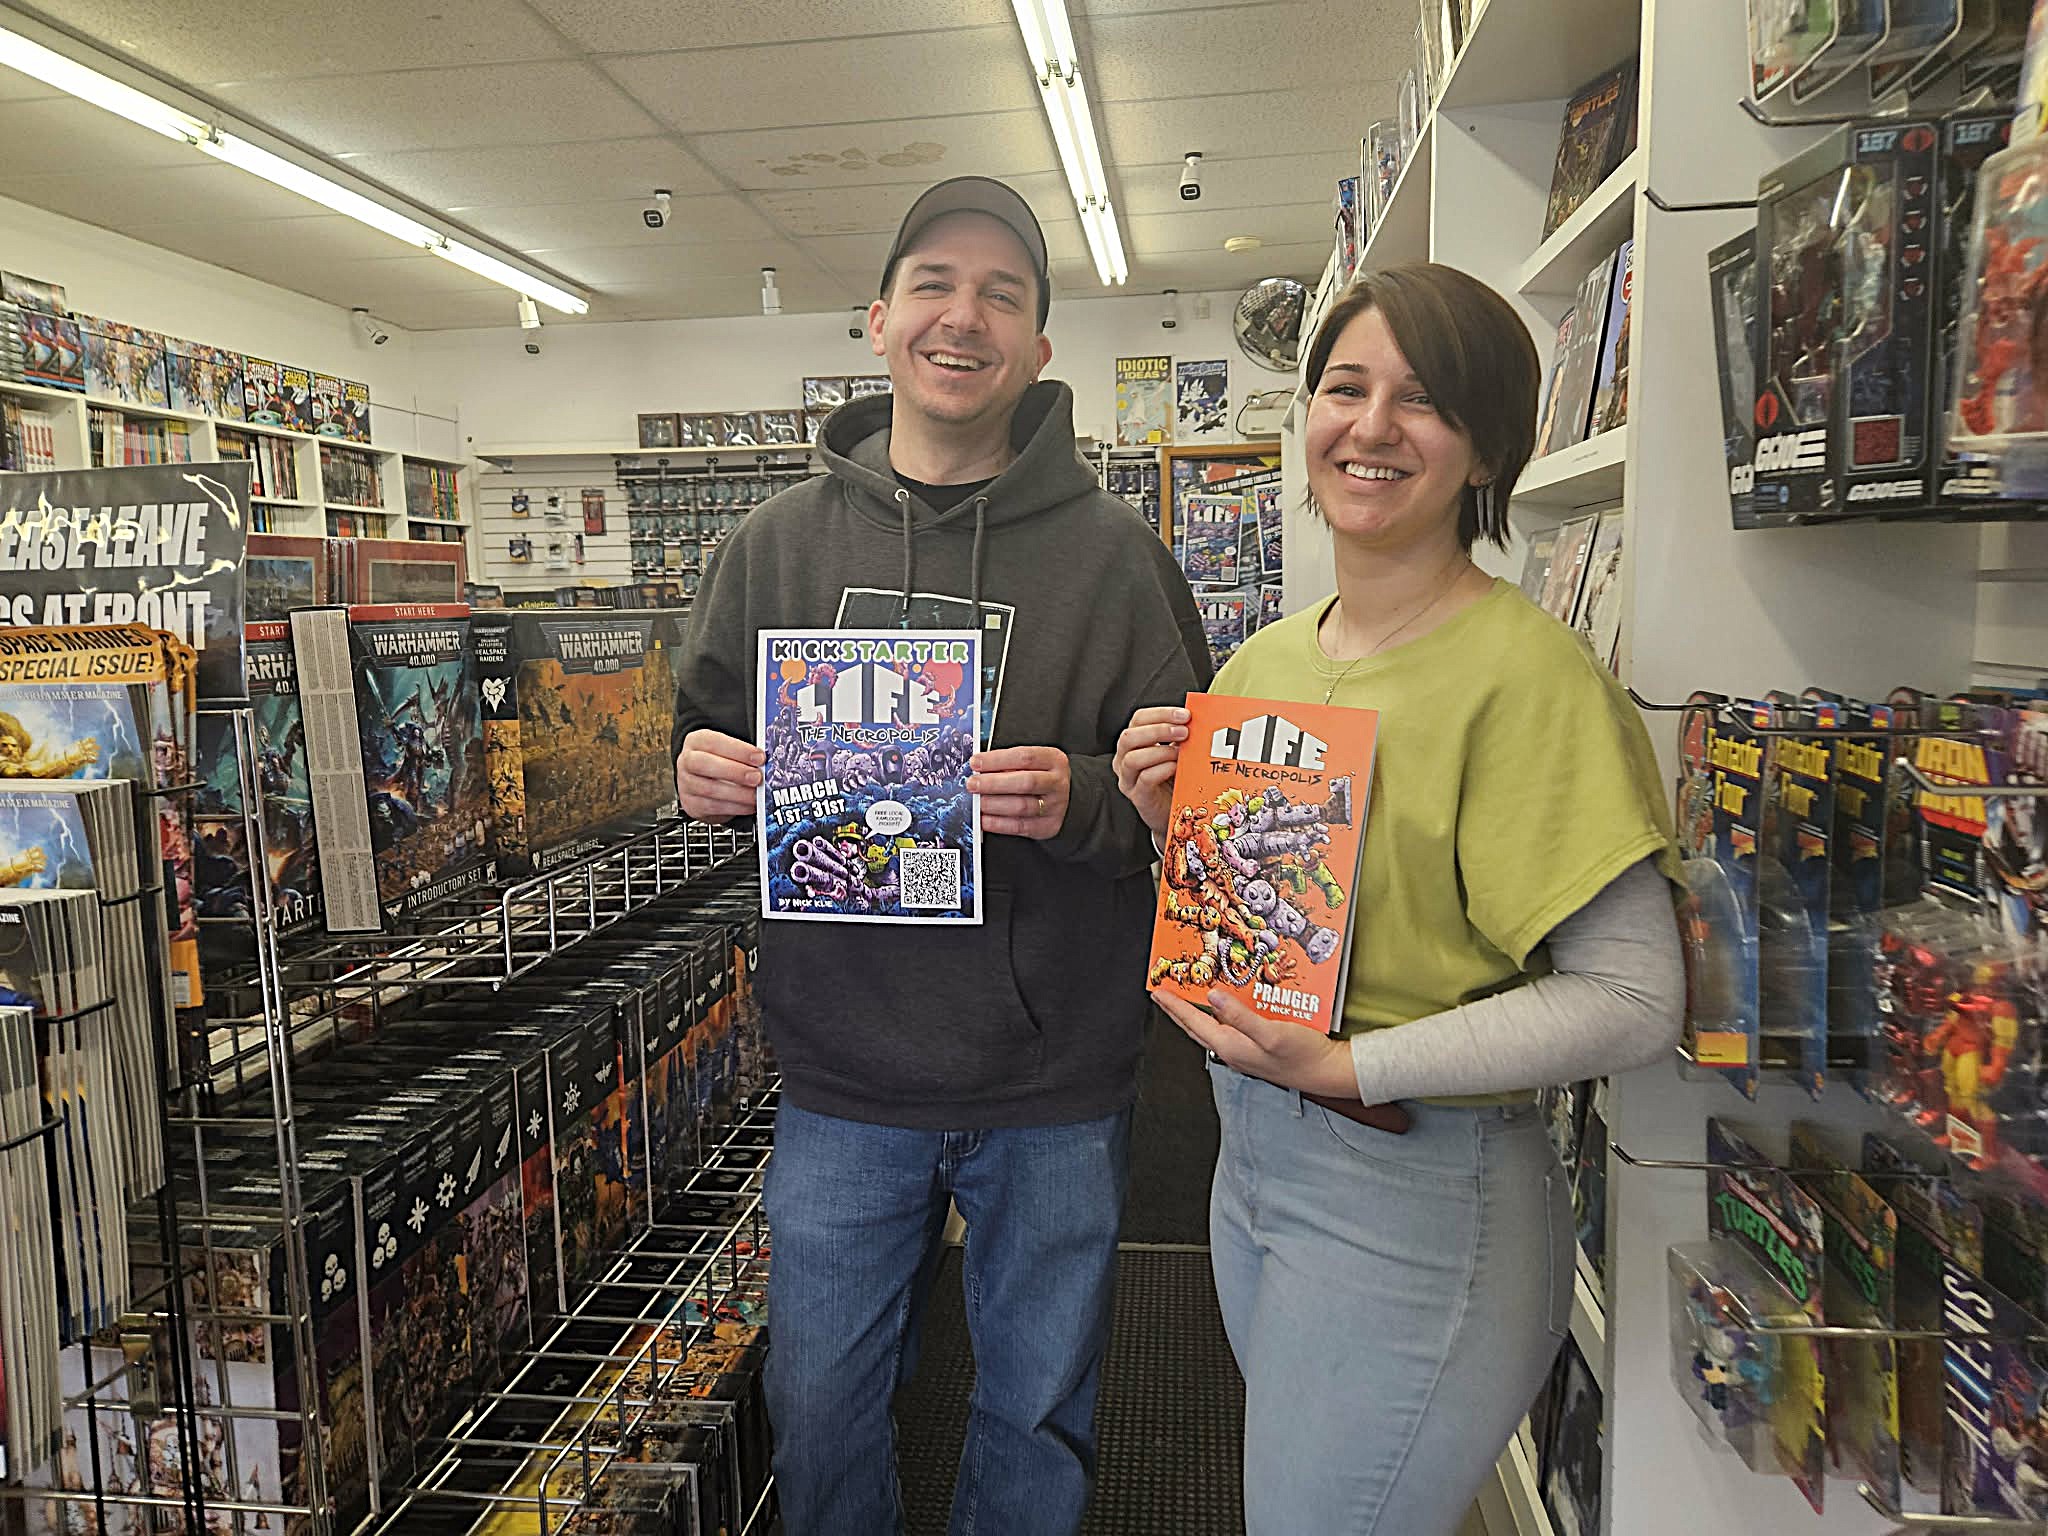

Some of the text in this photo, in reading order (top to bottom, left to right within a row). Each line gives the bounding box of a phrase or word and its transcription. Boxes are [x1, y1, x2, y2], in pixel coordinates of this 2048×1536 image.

[1117, 358, 1168, 372] IDIOTIC
[1124, 371, 1160, 380] IDEAS
[95, 502, 209, 569] LEAVE
[42, 593, 87, 626] AT
[94, 590, 211, 650] FRONT
[395, 606, 436, 617] START HERE
[0, 627, 153, 656] SPACE MARINES
[259, 625, 285, 637] START
[373, 631, 461, 657] WARHAMMER
[558, 630, 644, 660] WARHAMMER
[771, 639, 969, 664] KICKSTARTER
[0, 652, 155, 681] SPECIAL ISSUE!
[796, 663, 940, 725] LIFE
[796, 724, 940, 746] THE NECROPOLIS
[1210, 714, 1329, 770] LIFE
[1210, 760, 1323, 786] THE NECROPOLIS
[772, 778, 839, 807] MARCH
[774, 807, 801, 826] 1ST
[811, 798, 845, 818] 31ST
[542, 846, 575, 868] REALSPACE
[576, 837, 599, 853] RAIDERS
[407, 867, 482, 909] INTRODUCTORY SET
[792, 898, 813, 907] NICK
[1252, 981, 1321, 1014] PRANGER
[1270, 1004, 1292, 1016] NICK
[1715, 1191, 1808, 1300] TURTLES
